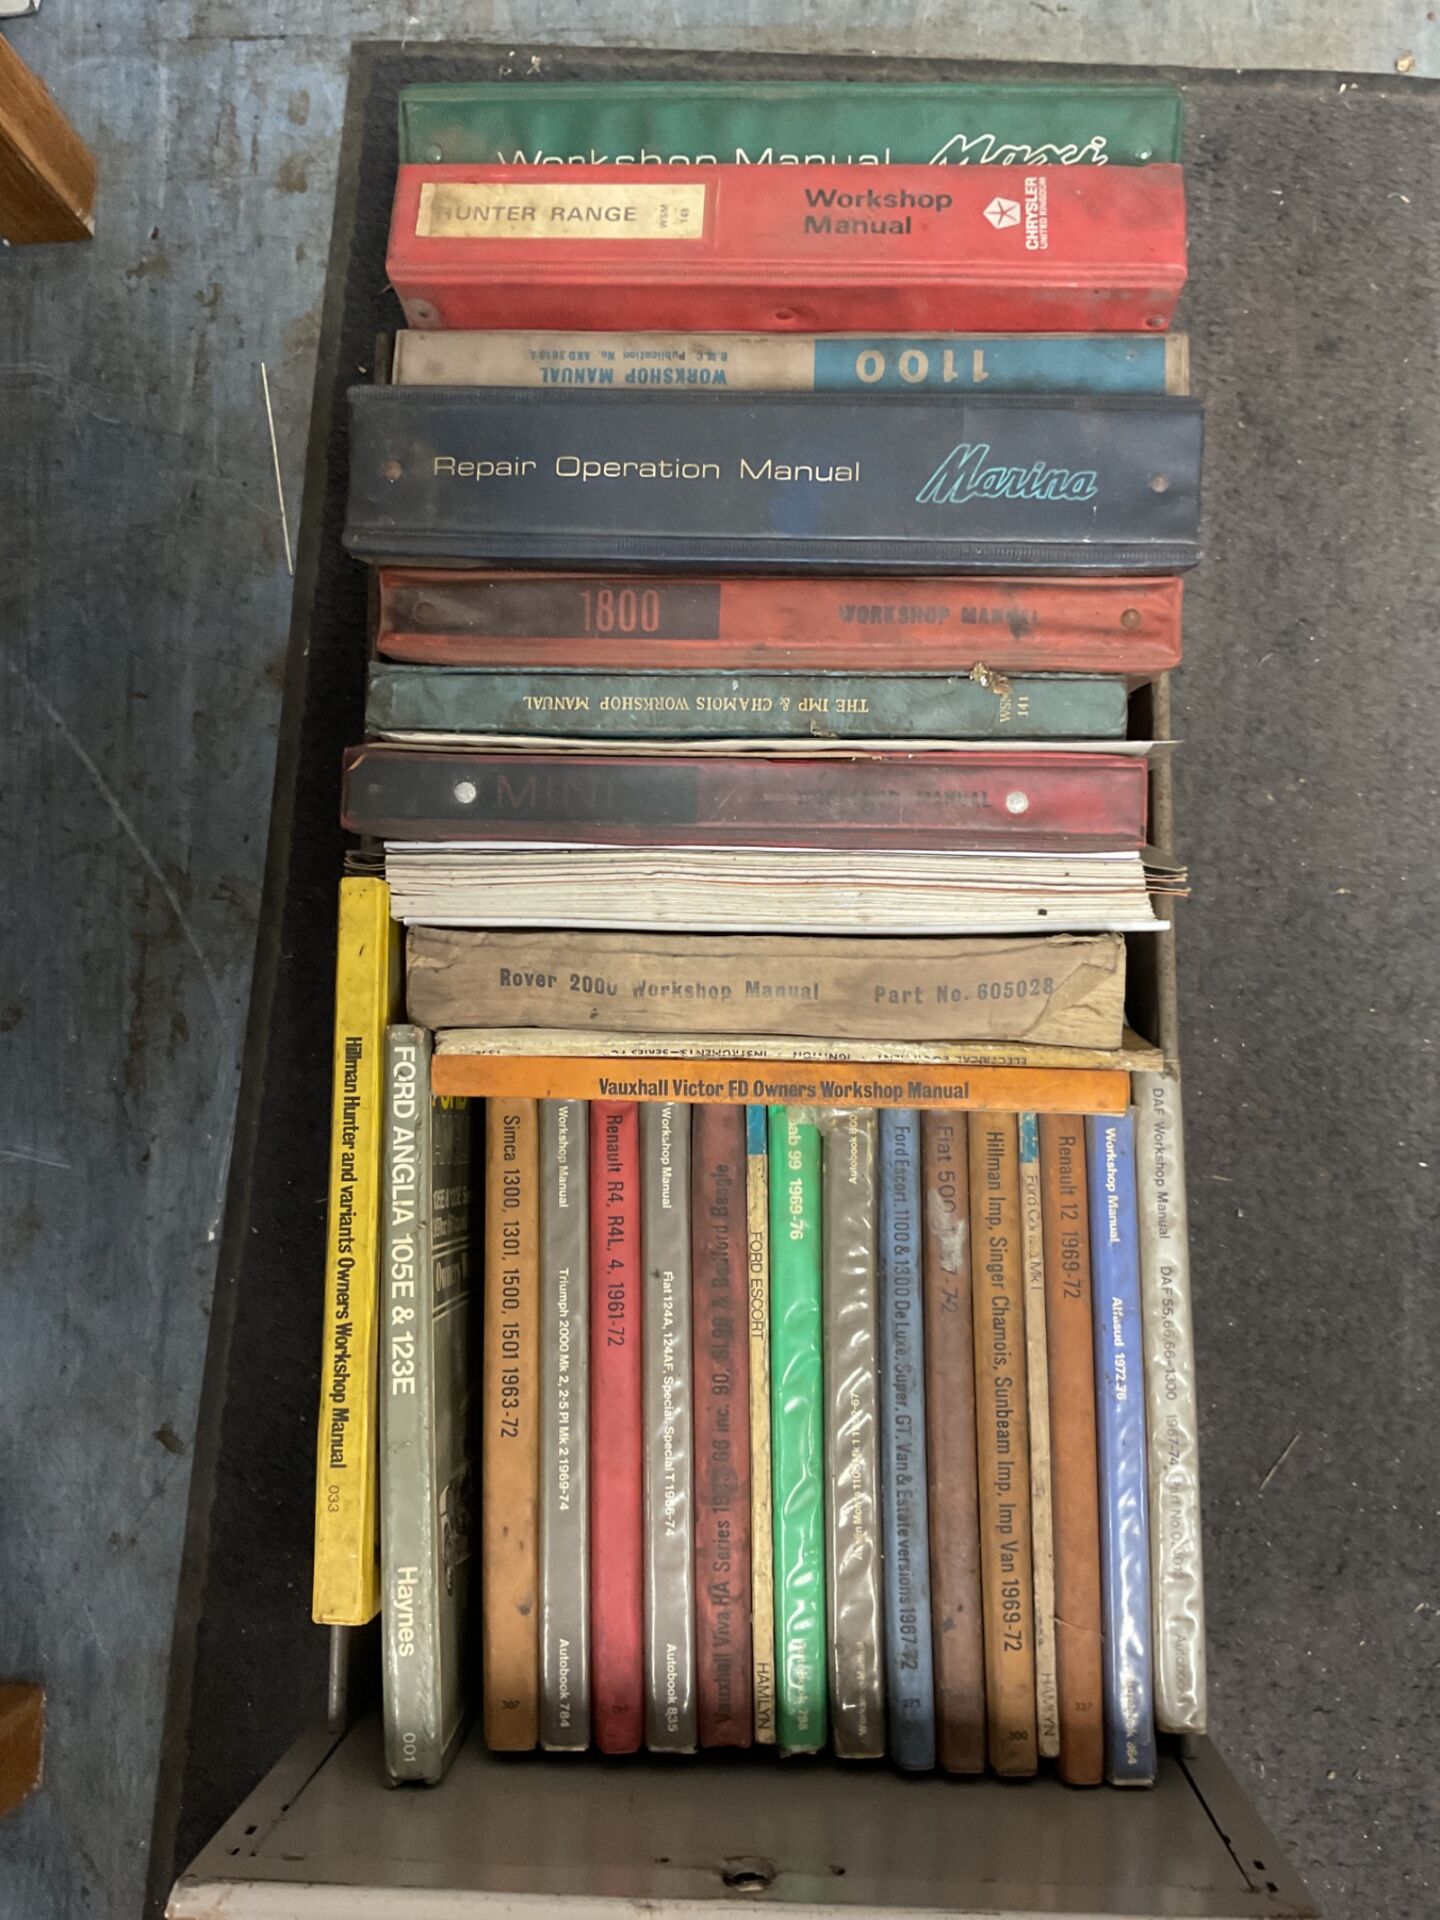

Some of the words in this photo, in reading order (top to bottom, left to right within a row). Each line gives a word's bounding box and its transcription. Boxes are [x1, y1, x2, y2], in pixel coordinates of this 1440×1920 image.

[551, 206, 637, 222] RANGE
[804, 189, 953, 212] Workshop
[1025, 177, 1039, 250] CHRYSLER
[804, 216, 912, 235] Manual
[1039, 216, 1048, 249] UNITED
[540, 367, 613, 385] MANUAL
[622, 350, 686, 362] Publication
[625, 368, 728, 385] WORKSHOP
[856, 349, 989, 383] 1100
[434, 457, 537, 481] Repair
[556, 456, 720, 482] Operation
[740, 459, 860, 482] Manual
[916, 443, 1099, 503] Marina
[580, 589, 661, 632] 1800
[840, 605, 950, 626] WORKSHOP
[523, 695, 589, 711] MANUAL
[600, 696, 689, 711] WORKSHOP
[696, 696, 773, 711] CHAMOIS
[779, 698, 790, 712] &
[798, 698, 829, 713] IMP
[835, 699, 869, 713] THE
[500, 968, 557, 989] Rover
[632, 979, 732, 1001] Workshop
[745, 981, 820, 1001] Manual
[874, 985, 923, 1004] Part
[937, 984, 969, 1002] No.
[977, 977, 1054, 1000] 605028
[344, 1037, 362, 1093] Hillman
[392, 1046, 415, 1119] FORD
[599, 1078, 668, 1096] Vauxhall
[672, 1079, 723, 1097] Victor
[728, 1080, 748, 1097] FD
[753, 1080, 816, 1098] Owners
[820, 1081, 903, 1101] Workshop
[907, 1081, 970, 1099] Manual
[1152, 1088, 1164, 1116] DAF
[342, 1096, 360, 1149] Hunter
[503, 1115, 521, 1161] Simca
[556, 1106, 569, 1163] Workshop
[660, 1107, 672, 1165] Workshop
[893, 1126, 910, 1156] Ford
[606, 1115, 624, 1173] Renault
[789, 1150, 802, 1170] 99
[848, 1136, 858, 1185] Autobook
[937, 1126, 954, 1162] Fiat
[986, 1132, 1004, 1190] Hillman
[1105, 1128, 1118, 1192] Workshop
[1153, 1122, 1167, 1187] Workshop
[341, 1152, 358, 1182] and
[391, 1126, 414, 1226] ANGLIA
[893, 1159, 910, 1207] Escort,
[1059, 1136, 1078, 1196] Renault
[501, 1168, 520, 1213] 1300,
[558, 1166, 569, 1208] Manual
[606, 1181, 624, 1207] R4,
[661, 1167, 673, 1208] Manual
[710, 1164, 732, 1217] Beagle
[338, 1185, 356, 1253] variants
[788, 1178, 804, 1240] 1969-76
[894, 1210, 910, 1242] 1100
[985, 1197, 1005, 1230] Imp,
[1061, 1203, 1078, 1220] 12
[1107, 1195, 1120, 1242] Manual
[1157, 1191, 1170, 1239] Manual
[501, 1220, 520, 1261] 1301,
[606, 1216, 624, 1251] R4L,
[750, 1231, 762, 1273] FORD
[894, 1245, 910, 1257] &
[391, 1233, 414, 1299] 105E
[710, 1225, 730, 1287] Bedford
[987, 1237, 1007, 1289] Singer
[1030, 1261, 1042, 1282] Mk
[1061, 1231, 1081, 1298] 1969-72
[336, 1257, 355, 1319] Owners
[500, 1269, 519, 1314] 1500,
[557, 1268, 570, 1317] Triumph
[663, 1271, 675, 1294] Fiat
[894, 1260, 911, 1297] 1300
[1160, 1266, 1173, 1296] DAF
[391, 1305, 415, 1326] &
[607, 1282, 625, 1347] 1961-72
[661, 1296, 673, 1329] 124A,
[750, 1278, 764, 1340] ESCORT
[895, 1301, 911, 1320] De
[1111, 1297, 1125, 1347] Alfasud
[502, 1323, 519, 1360] 1501
[559, 1320, 570, 1352] 2000
[661, 1332, 674, 1374] 124AF,
[991, 1296, 1010, 1370] Chamois,
[329, 1322, 353, 1403] Workshop
[391, 1330, 415, 1395] 123E
[557, 1375, 569, 1387] 2,
[559, 1354, 570, 1372] Mk
[501, 1367, 519, 1439] 1963-72
[661, 1376, 675, 1424] Special,
[711, 1404, 730, 1432] inc.
[994, 1377, 1012, 1454] Sunbeam
[330, 1408, 349, 1469] Manual
[559, 1426, 570, 1444] Mk
[559, 1447, 569, 1456] 2
[662, 1426, 675, 1472] Special
[664, 1473, 675, 1482] T
[896, 1445, 911, 1474] Van
[896, 1474, 911, 1485] &
[995, 1461, 1015, 1497] Imp,
[328, 1485, 340, 1513] 033
[558, 1457, 570, 1511] 1969-74
[896, 1489, 914, 1537] Estate
[996, 1504, 1017, 1534] Imp
[711, 1520, 731, 1572] Series
[1001, 1541, 1018, 1572] Van
[898, 1540, 915, 1605] versions
[393, 1566, 419, 1657] Haynes
[711, 1581, 731, 1606] HA
[712, 1611, 731, 1647] Viva
[1002, 1579, 1022, 1652] 1969-72
[559, 1639, 571, 1699] Autobook
[666, 1644, 678, 1704] Autobook
[711, 1652, 732, 1723] Vauxhall
[559, 1703, 570, 1727] 784
[756, 1662, 771, 1730] HAMLYN
[666, 1707, 679, 1732] 835
[403, 1732, 416, 1762] 001
